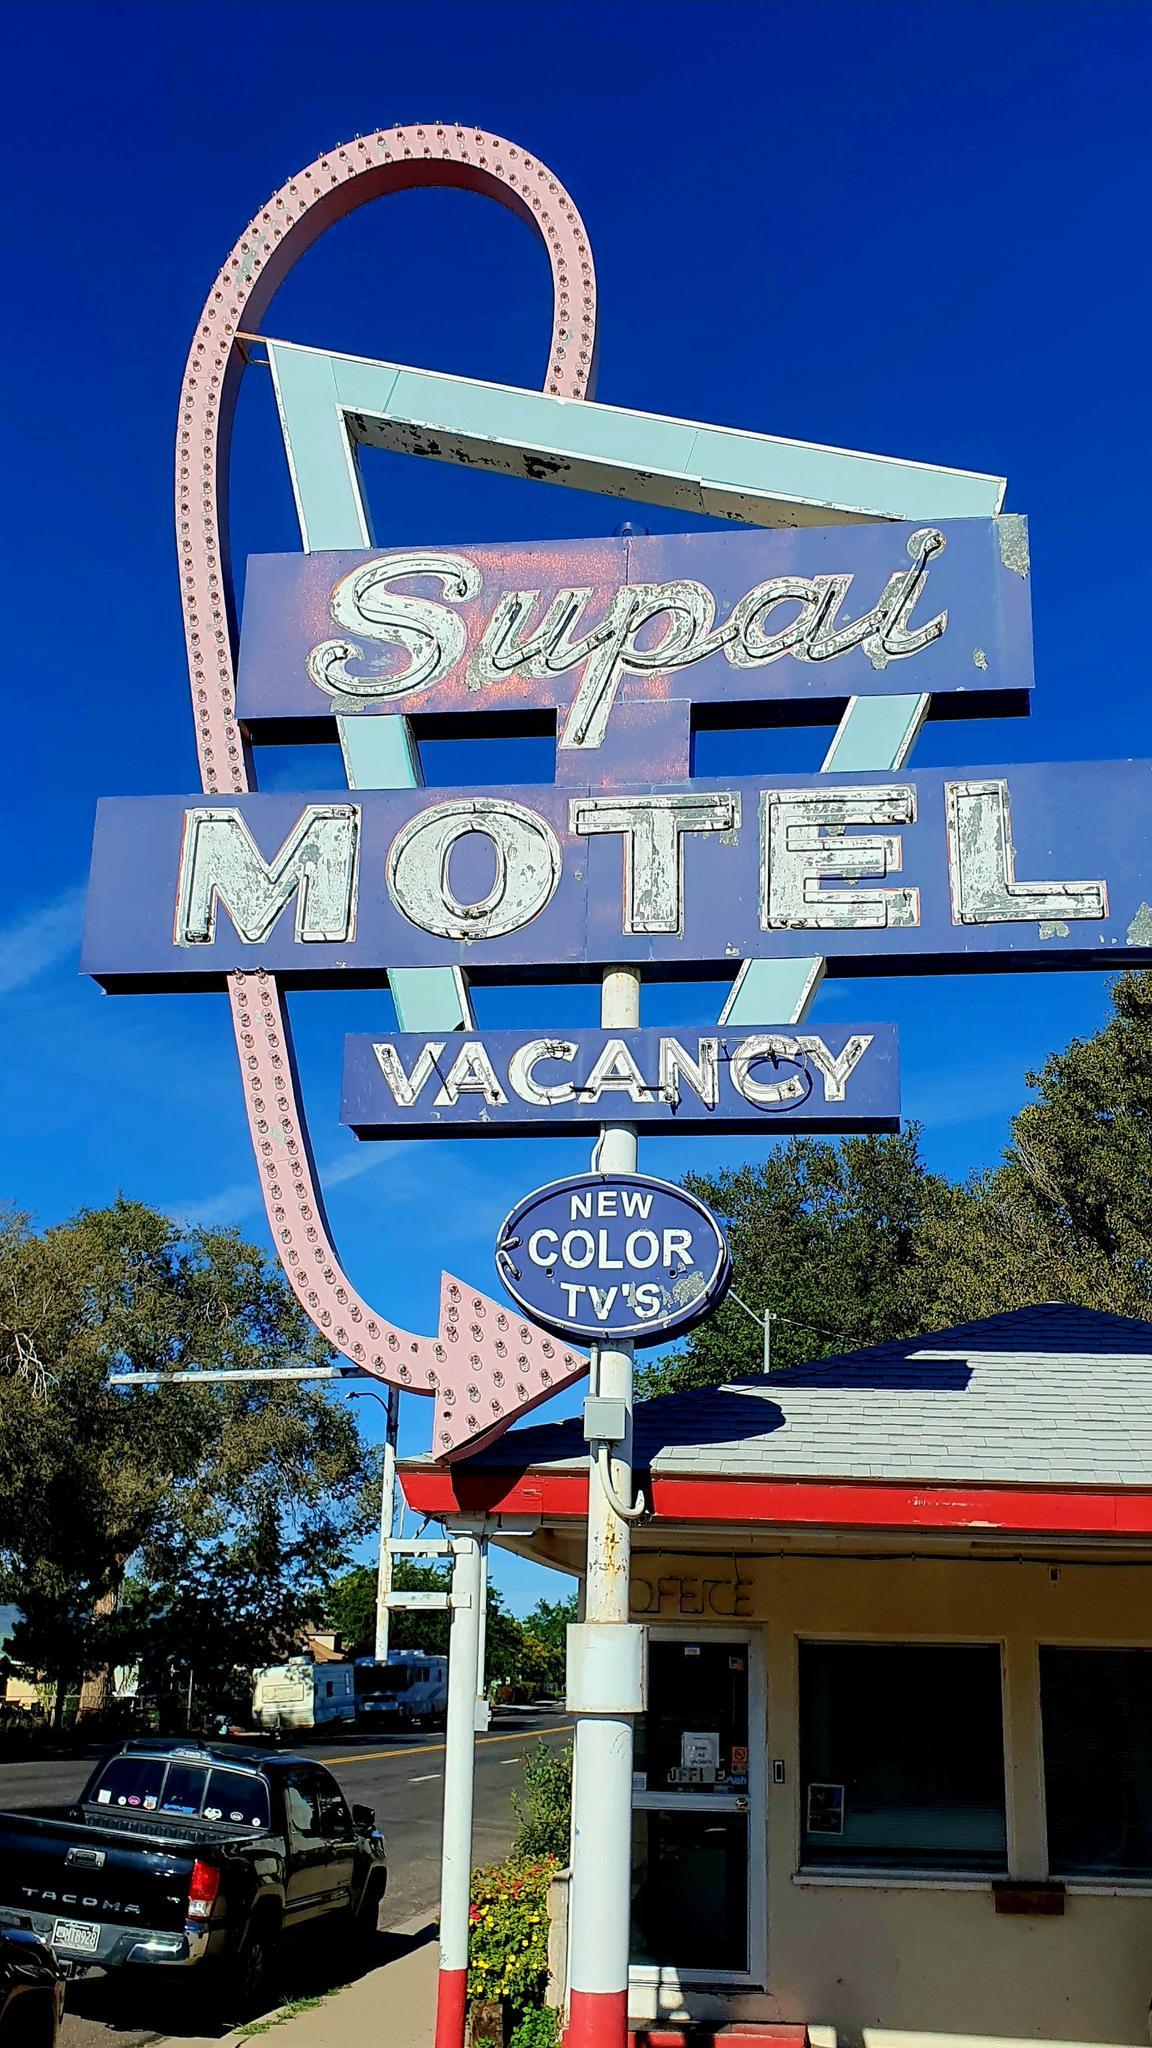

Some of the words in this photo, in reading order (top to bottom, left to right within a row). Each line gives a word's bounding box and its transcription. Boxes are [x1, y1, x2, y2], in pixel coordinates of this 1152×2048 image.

[305, 527, 948, 750] Supai
[171, 778, 1109, 946] MOTEL
[370, 1033, 875, 1107] VACANCY
[570, 1190, 654, 1221] NEW
[528, 1228, 695, 1270] COLOR
[560, 1281, 662, 1321] TV'S
[21, 1886, 141, 1915] TACOMA
